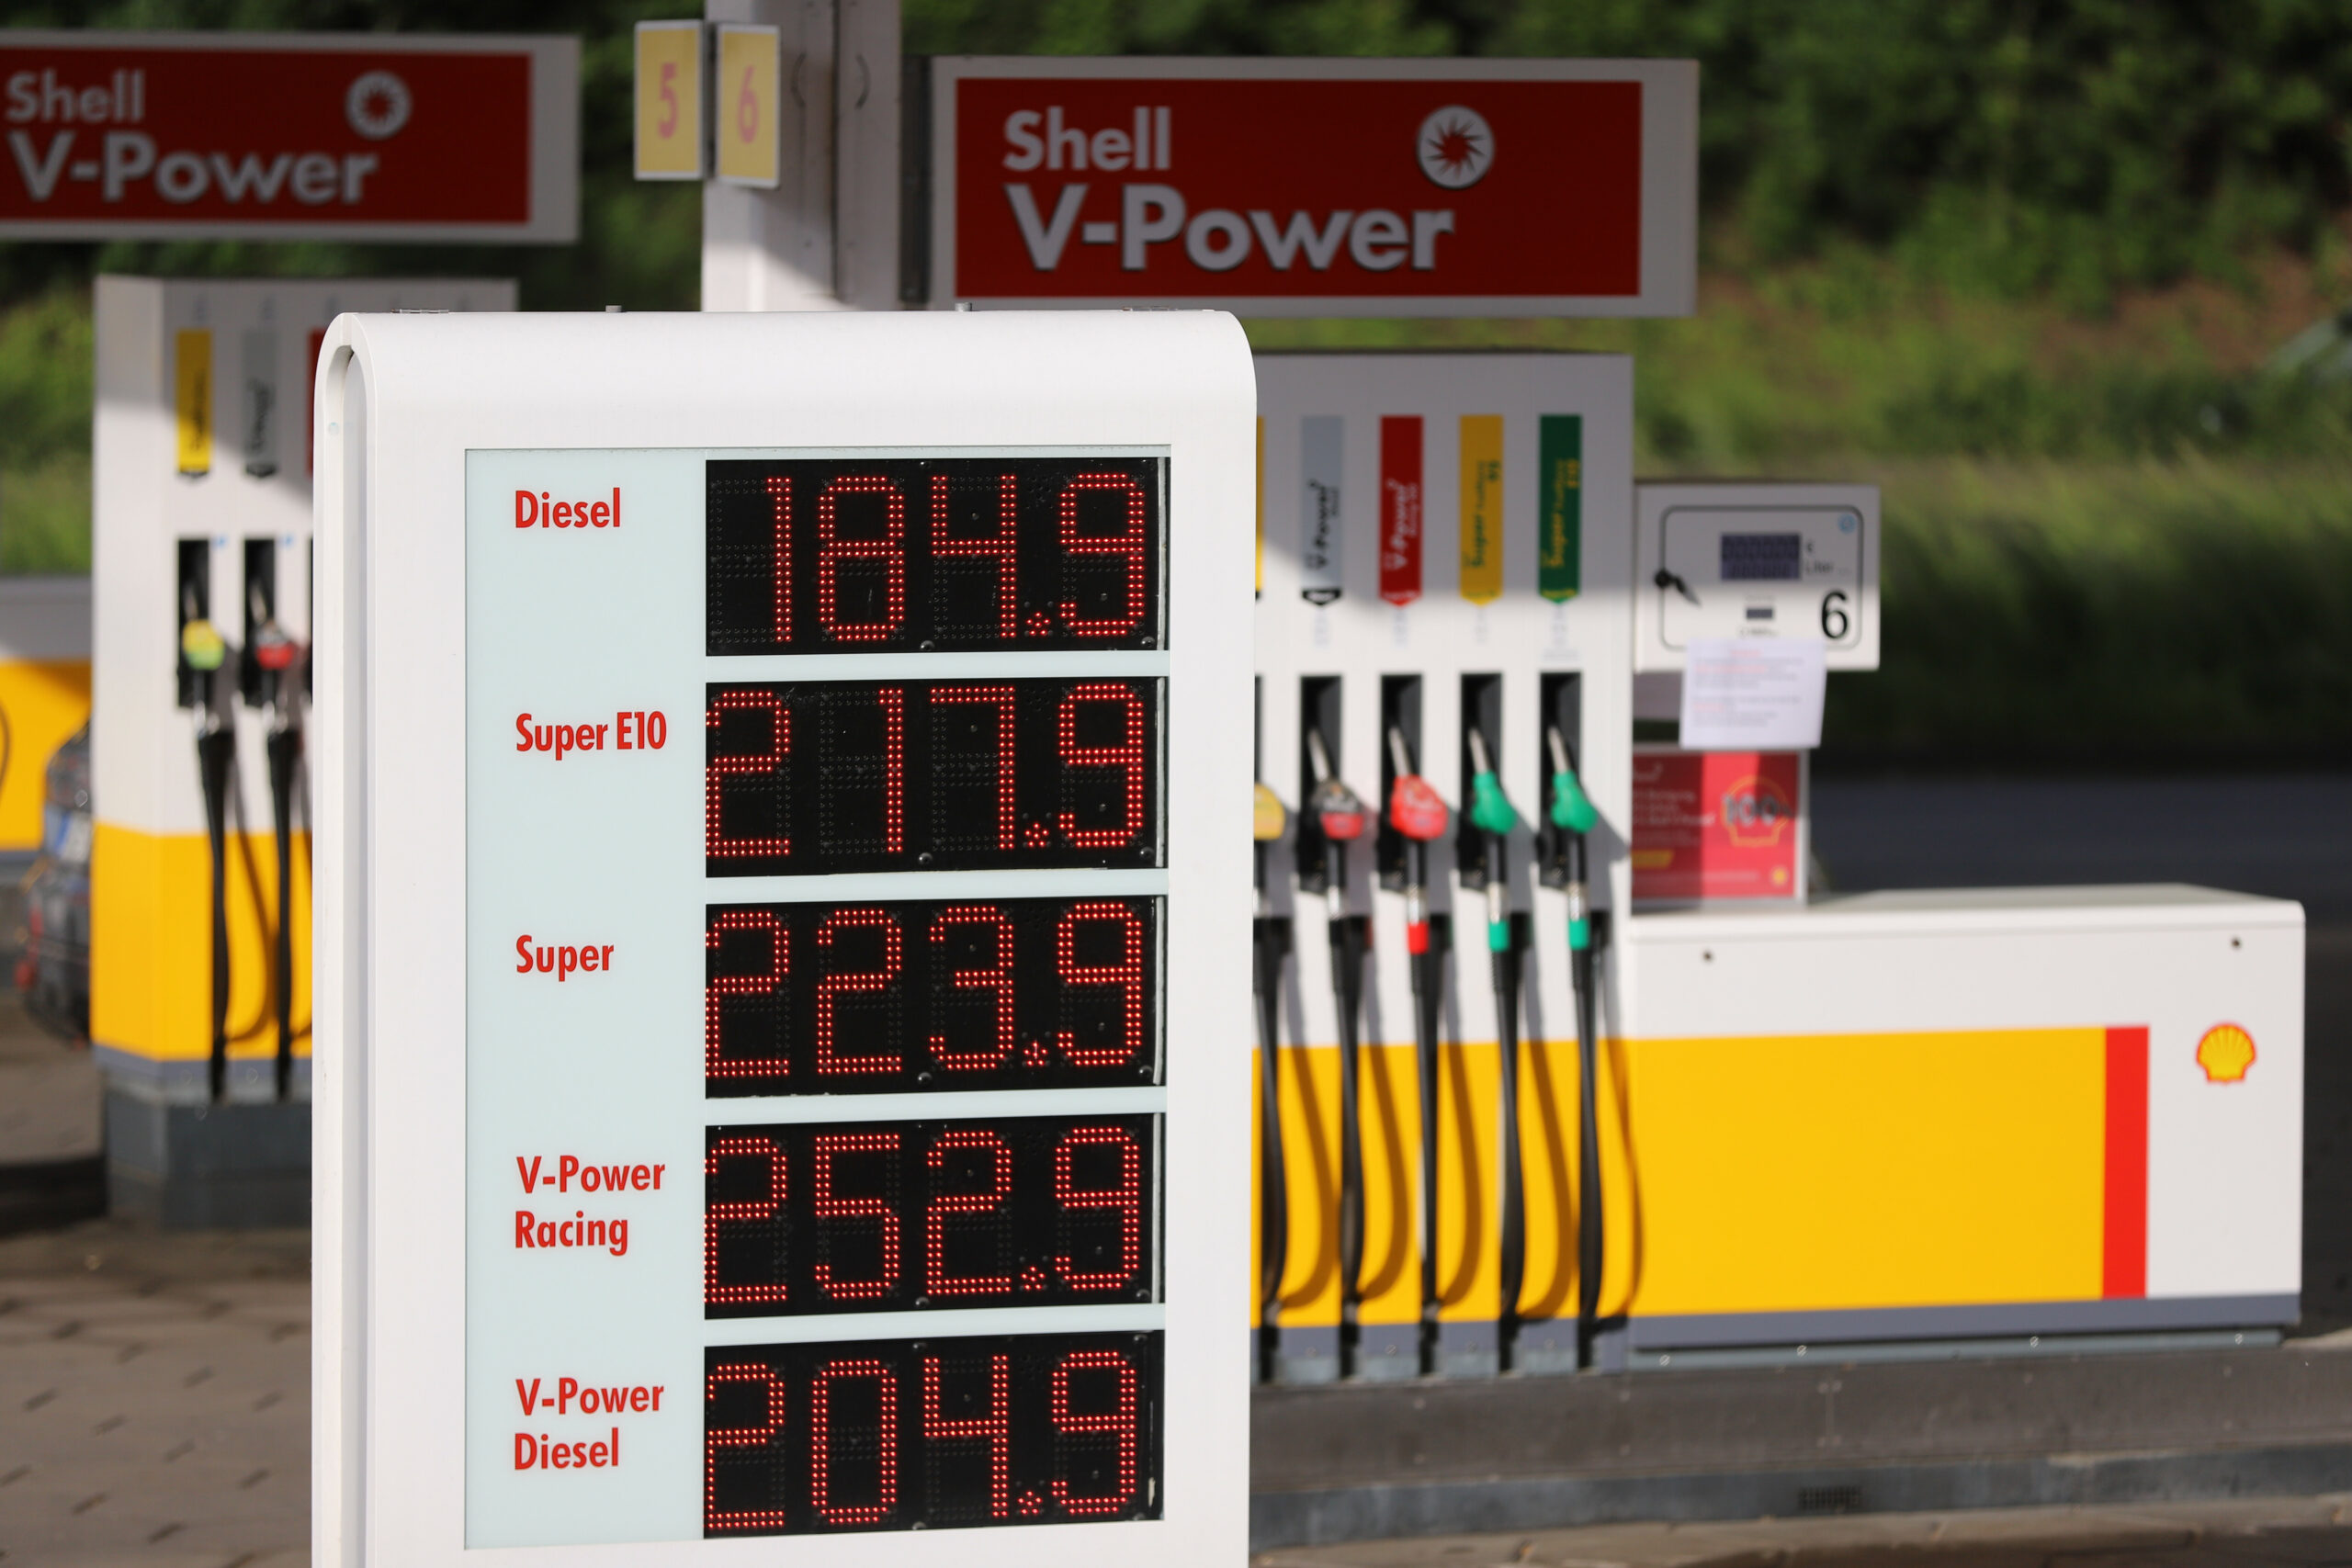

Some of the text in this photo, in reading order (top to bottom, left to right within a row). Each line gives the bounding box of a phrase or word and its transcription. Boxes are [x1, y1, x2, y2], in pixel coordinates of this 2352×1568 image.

[6, 70, 144, 124] Shell
[658, 62, 679, 140] 5
[738, 64, 758, 144] 6
[7, 130, 378, 204] V-Power
[1002, 106, 1171, 172] Shell
[1004, 183, 1454, 272] V-Power
[514, 487, 621, 529] Diesel
[766, 473, 1145, 641] 184.9
[1821, 590, 1849, 639] 6
[514, 710, 668, 761] Super E10
[706, 683, 1144, 857] 217.9
[514, 933, 616, 983] Super
[705, 902, 1143, 1077] 223.9
[515, 1154, 667, 1194] V-Power
[514, 1209, 629, 1258] Racing
[704, 1126, 1140, 1303] 252.9
[515, 1377, 665, 1416] V-Power
[514, 1427, 619, 1471] Diesel
[705, 1350, 1136, 1529] 204.9
